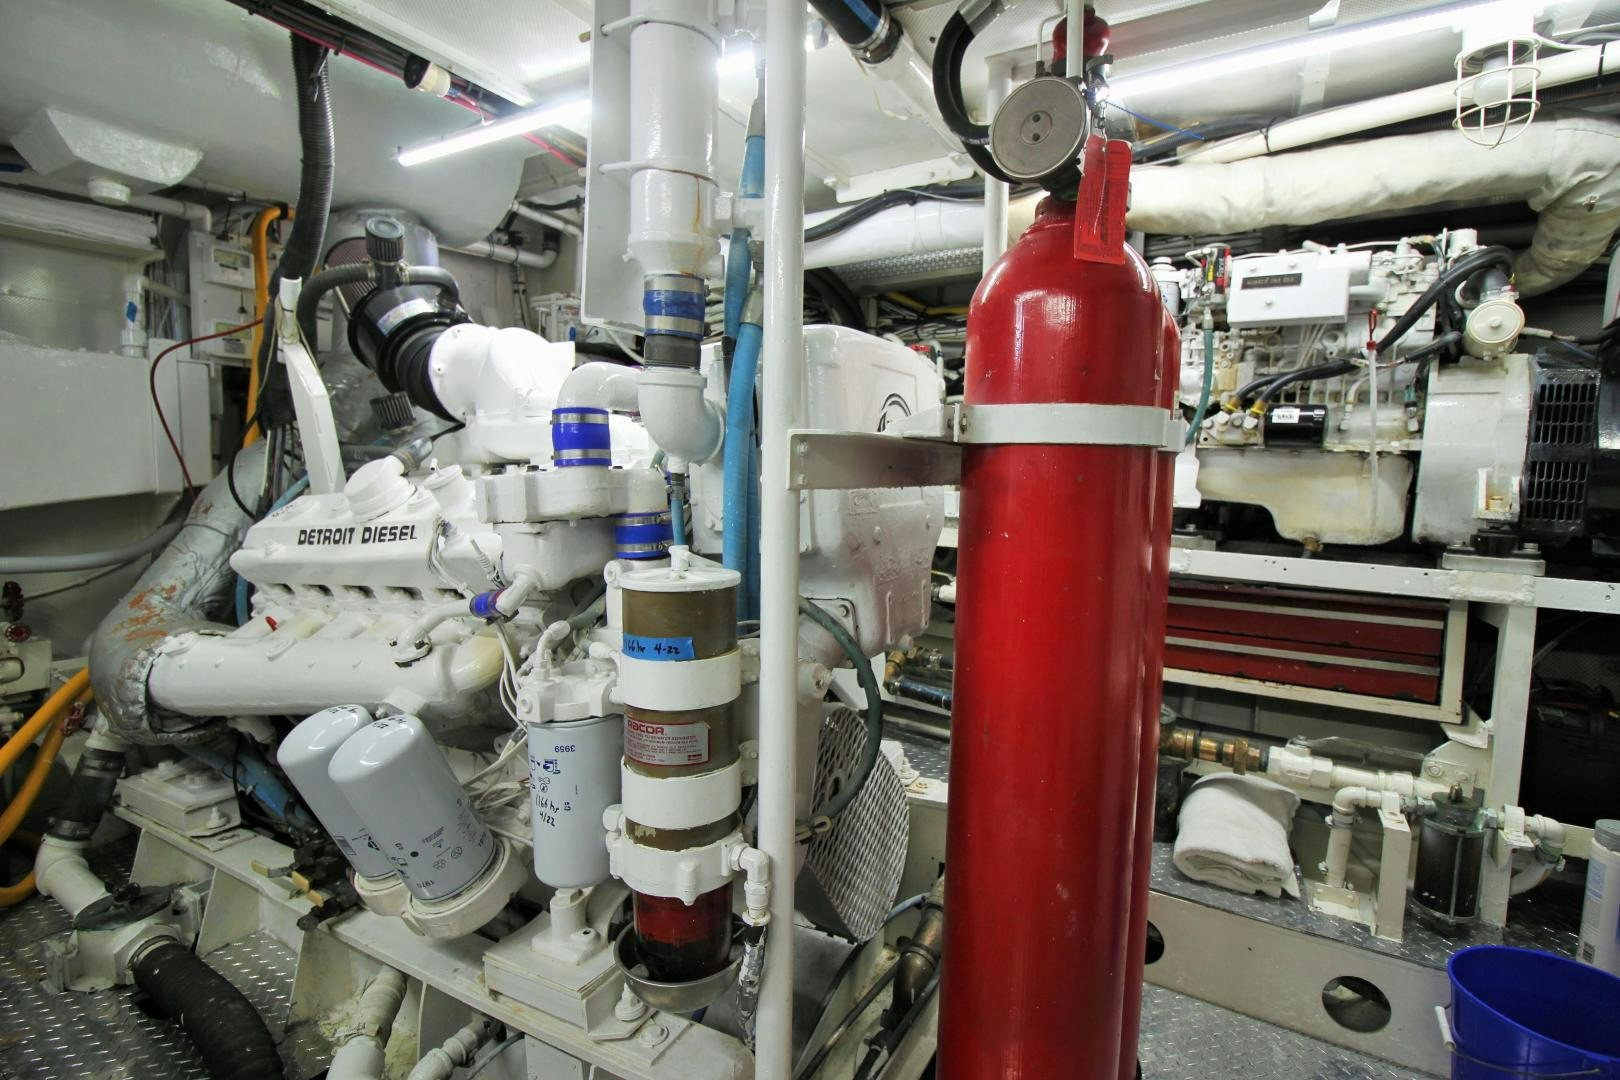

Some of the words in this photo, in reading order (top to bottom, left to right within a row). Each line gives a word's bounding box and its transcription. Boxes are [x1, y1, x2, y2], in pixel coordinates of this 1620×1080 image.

[297, 527, 356, 545] DETROIT
[361, 524, 418, 544] DIESEL
[554, 744, 576, 753] 3959
[539, 811, 556, 827] 4/22
